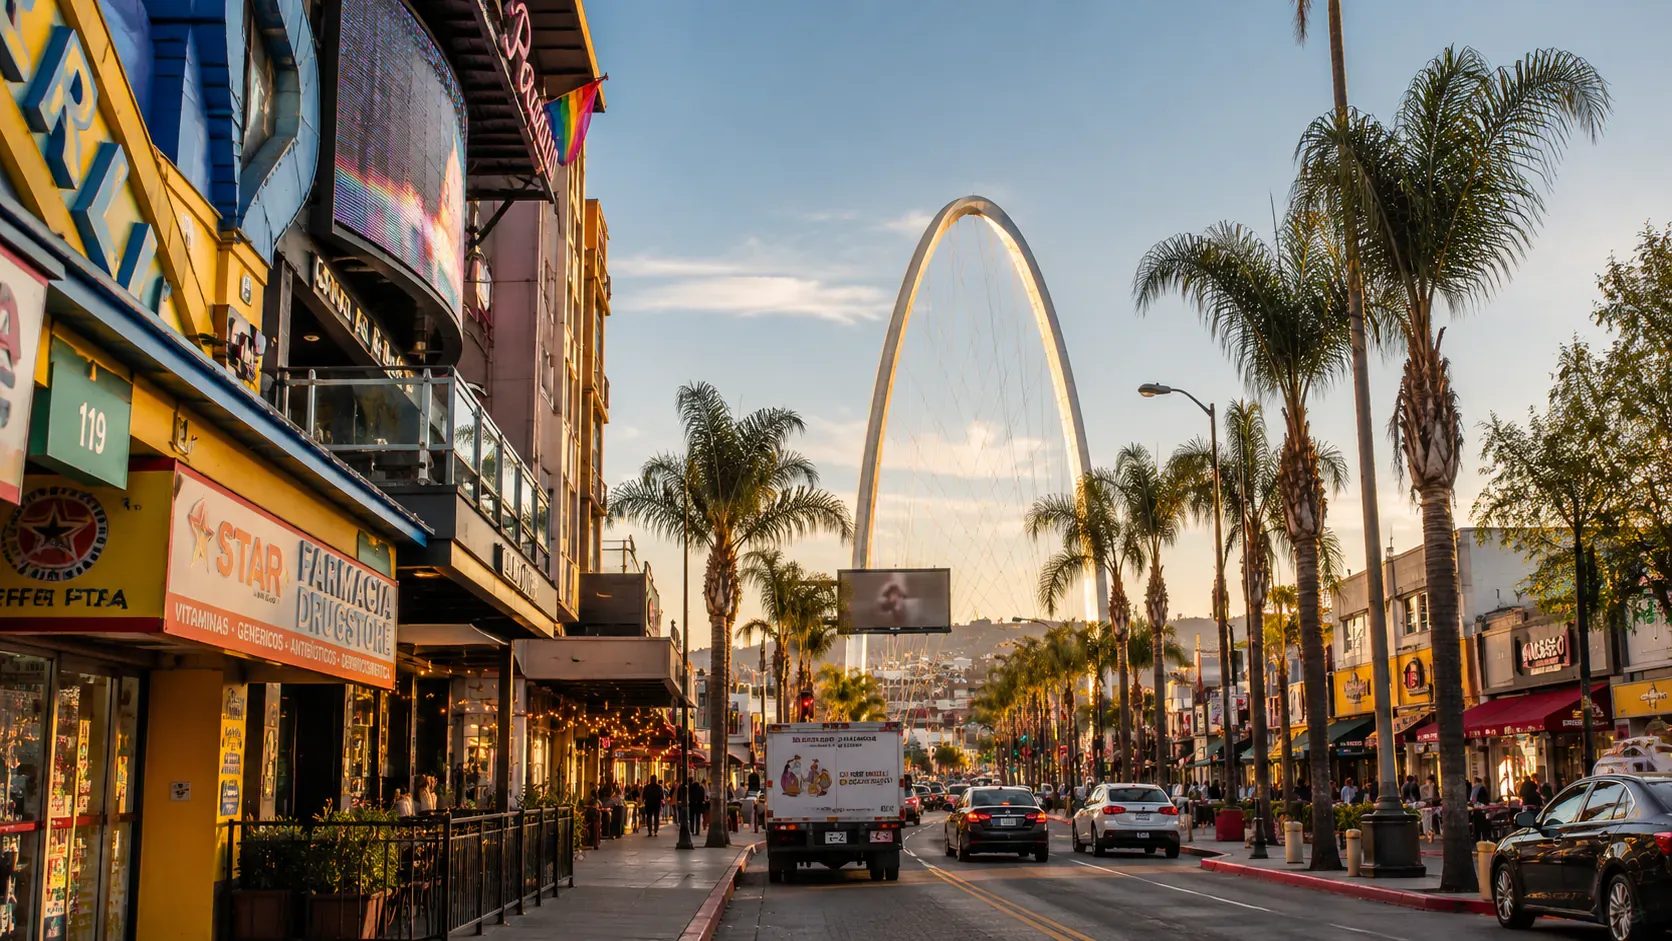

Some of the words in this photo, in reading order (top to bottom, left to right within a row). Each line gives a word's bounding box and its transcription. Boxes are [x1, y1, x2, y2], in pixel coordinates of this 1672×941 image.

[79, 401, 107, 455] 119
[216, 520, 283, 598] STAR
[297, 539, 392, 620] FARMACIA
[175, 602, 229, 636] VITAMINAS
[237, 621, 284, 652] GENERICOS
[296, 585, 392, 657] DRUGSTORE
